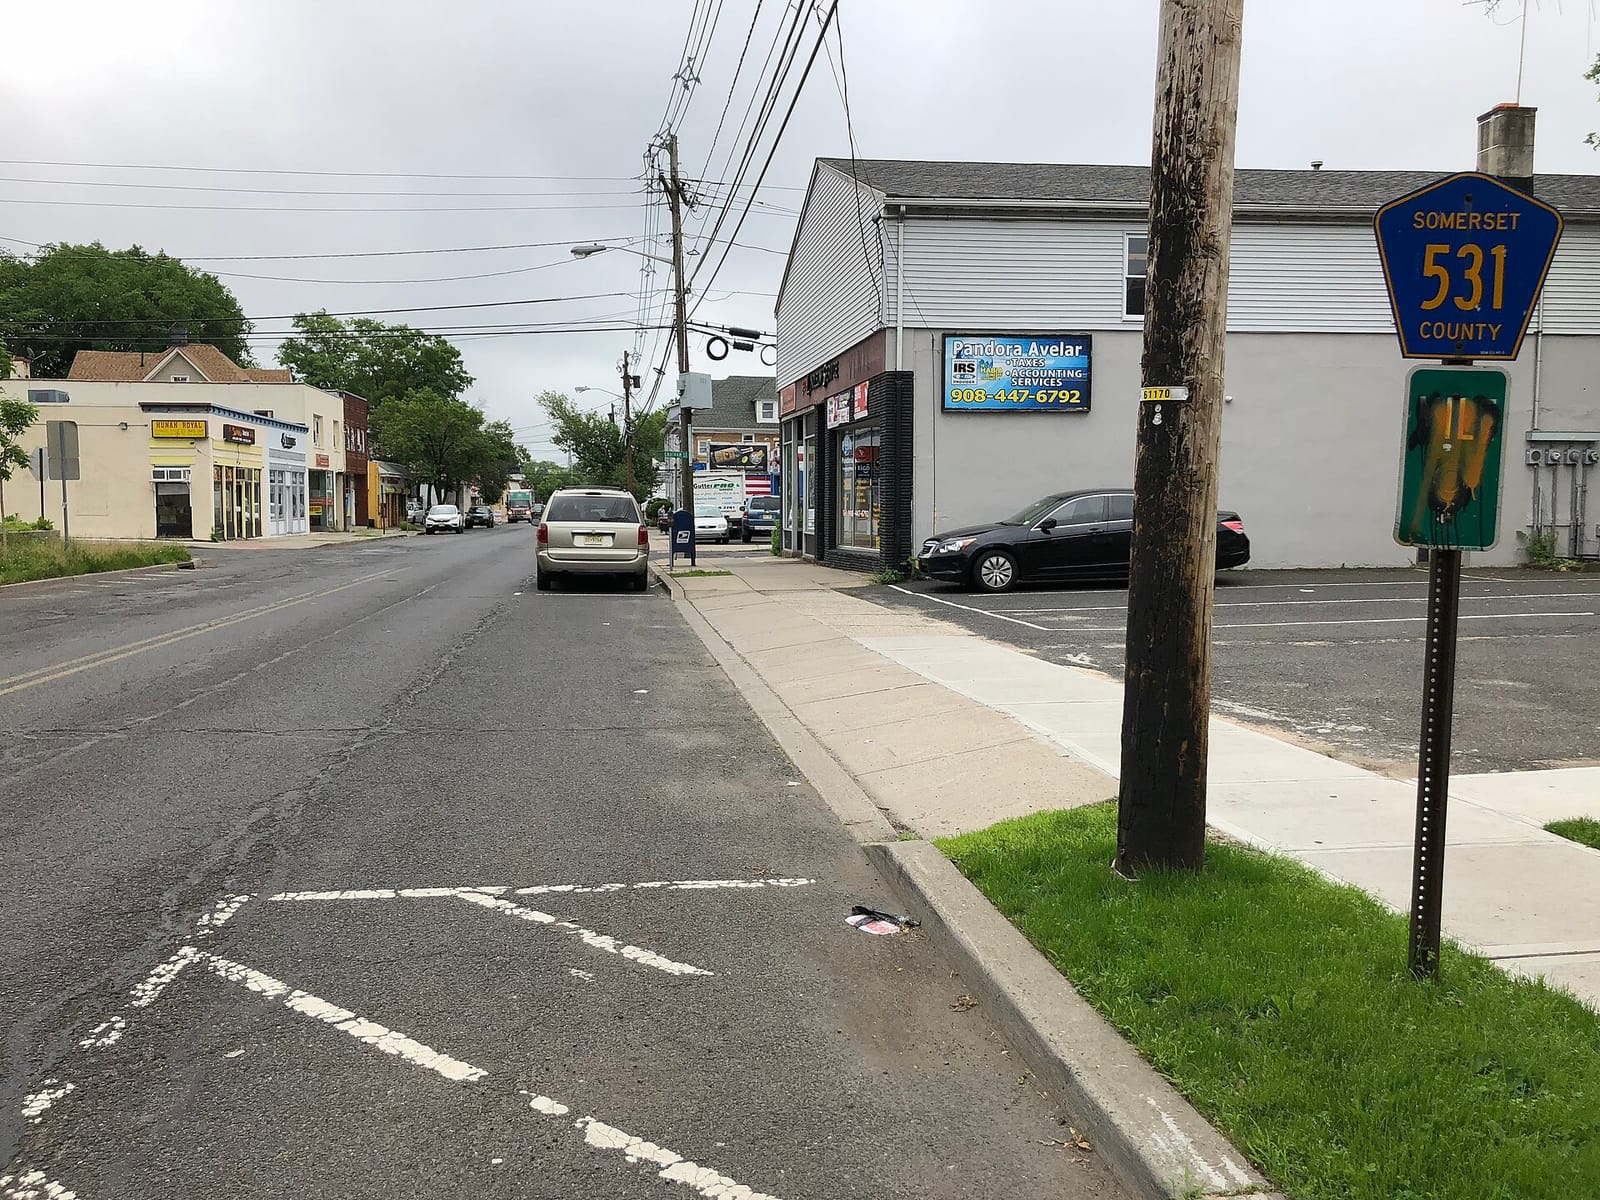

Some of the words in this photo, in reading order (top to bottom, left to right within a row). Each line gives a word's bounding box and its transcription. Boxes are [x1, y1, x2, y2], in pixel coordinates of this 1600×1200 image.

[1412, 211, 1521, 231] SOMERSET
[1420, 243, 1508, 312] 531
[1419, 321, 1502, 341] COUNTY
[952, 341, 1023, 357] Pandora
[1028, 341, 1082, 357] Avelar
[953, 363, 976, 373] IRS
[1011, 358, 1046, 367] TAXES
[1011, 369, 1082, 378] ACCOUNTING
[1011, 378, 1063, 387] SERVICES
[951, 389, 1081, 403] 908-447-6792
[1143, 389, 1170, 400] 61170
